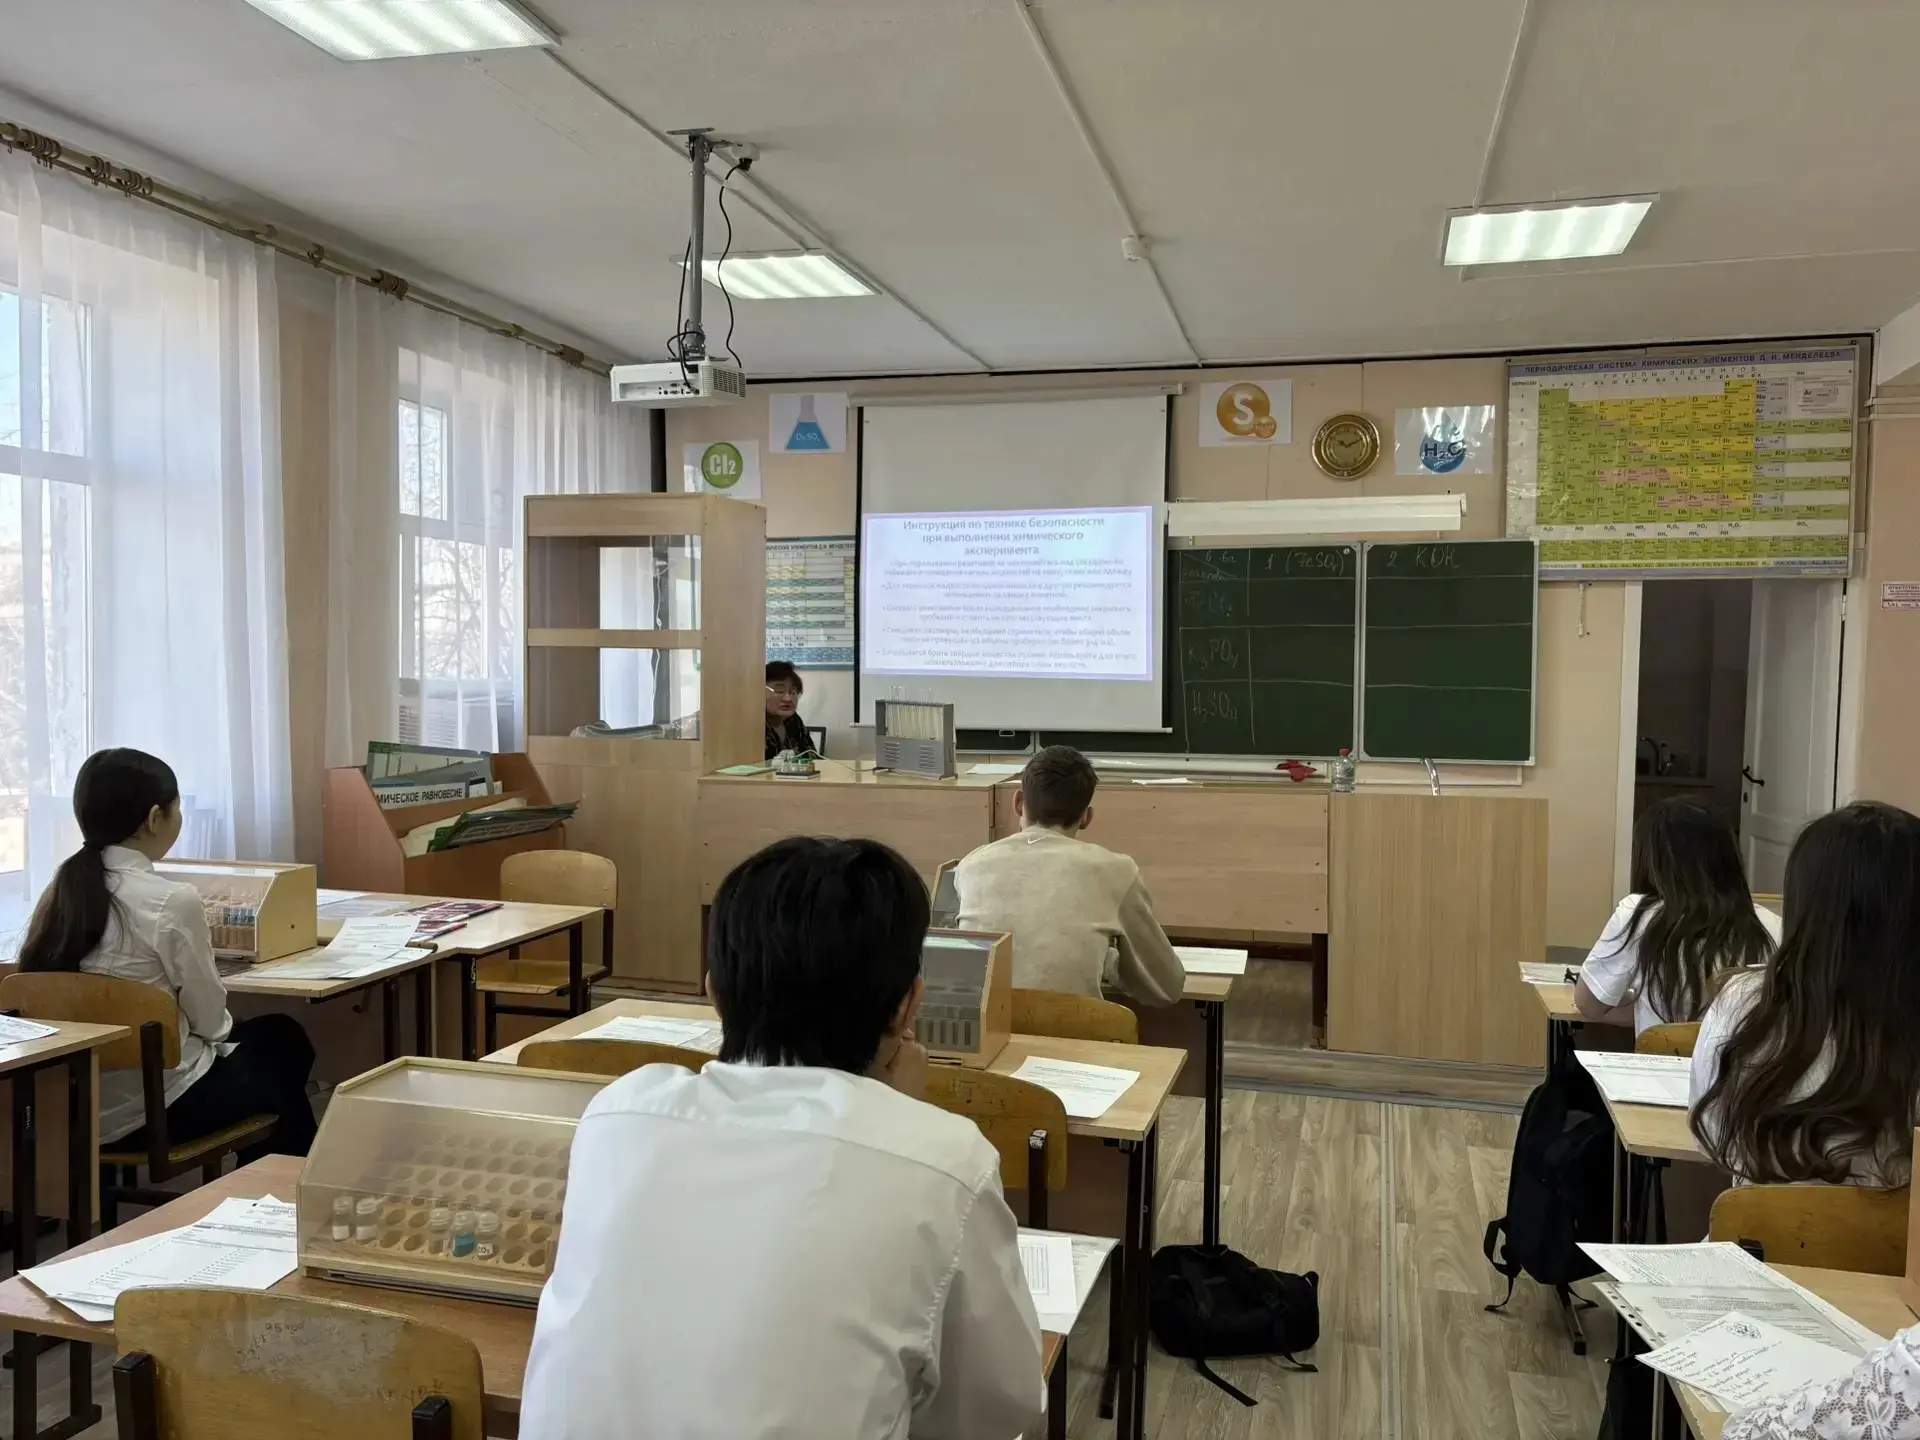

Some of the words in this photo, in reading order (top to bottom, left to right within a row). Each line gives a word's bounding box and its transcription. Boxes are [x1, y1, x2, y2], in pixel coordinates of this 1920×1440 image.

[1524, 363, 1594, 373] ПЕРИОДИЧЕСКАЯ
[1598, 361, 1637, 370] СИСТЕМА
[1642, 357, 1698, 369] ХИМИЧЕСКИХ
[1702, 354, 1754, 364] ЭЛЕМЕНТОВ
[1782, 350, 1840, 360] МЕНДЕЛЕЕВА
[1232, 393, 1254, 425] S
[709, 454, 736, 476] Cl2
[904, 520, 966, 532] Инструкция
[968, 520, 980, 529] по
[984, 520, 1026, 530] технике
[1029, 517, 1104, 528] безопасности
[922, 534, 942, 544] при
[944, 533, 1010, 542] выполнении
[1013, 531, 1084, 541] химического
[964, 546, 1039, 558] эксперимента
[1386, 550, 1398, 568] 2
[1415, 544, 1461, 568] KOH
[1192, 688, 1240, 724] H2SO4
[376, 792, 419, 804] МИЧЕСКОЕ
[422, 788, 462, 800] РАВНОВЕСИЕ
